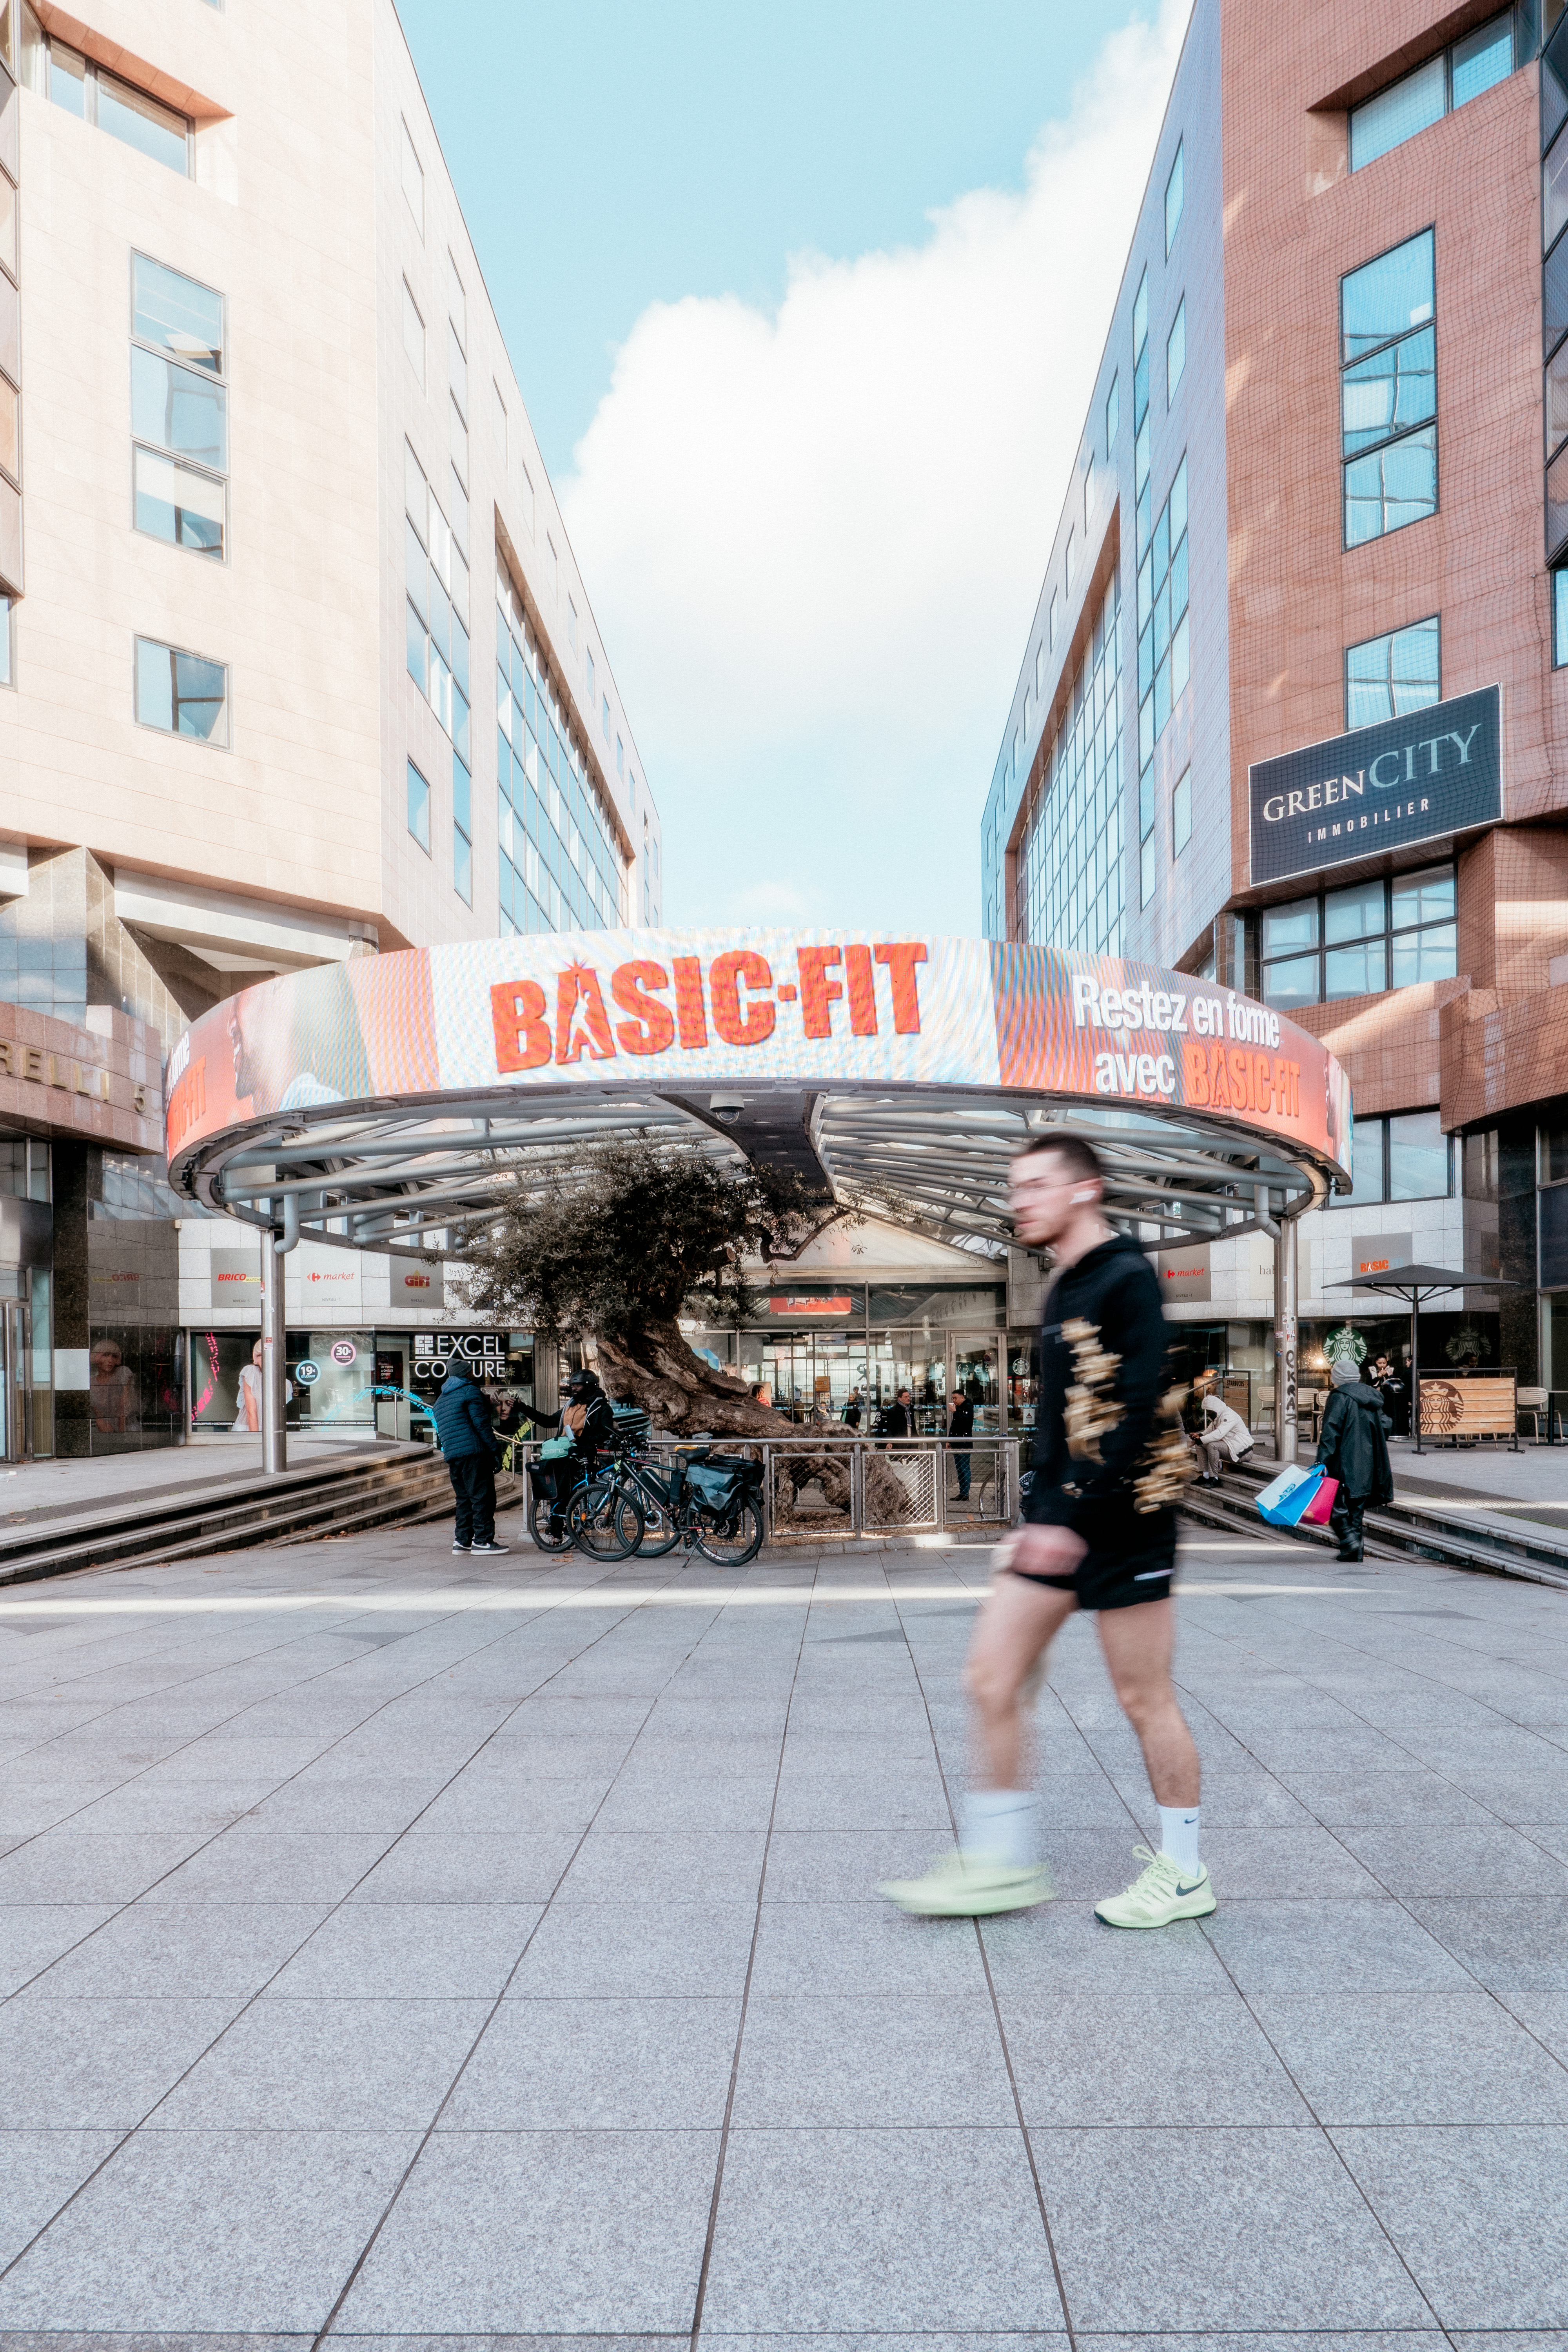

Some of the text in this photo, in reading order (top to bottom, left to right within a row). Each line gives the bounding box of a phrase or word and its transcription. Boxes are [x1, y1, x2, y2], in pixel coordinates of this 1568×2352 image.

[1308, 797, 1430, 844] IMMOBILIER
[490, 942, 927, 1073] BASIC-FIT
[1072, 975, 1280, 1049] Restez en forme
[1095, 1040, 1300, 1118] avec BASIC-FIT
[134, 1085, 147, 1112] 5
[323, 1272, 354, 1280] market
[1177, 1267, 1205, 1276] market
[336, 1347, 352, 1356] 30€
[437, 1336, 505, 1356] EXCEL
[301, 1366, 316, 1375] 19€
[415, 1361, 505, 1378] COURE
